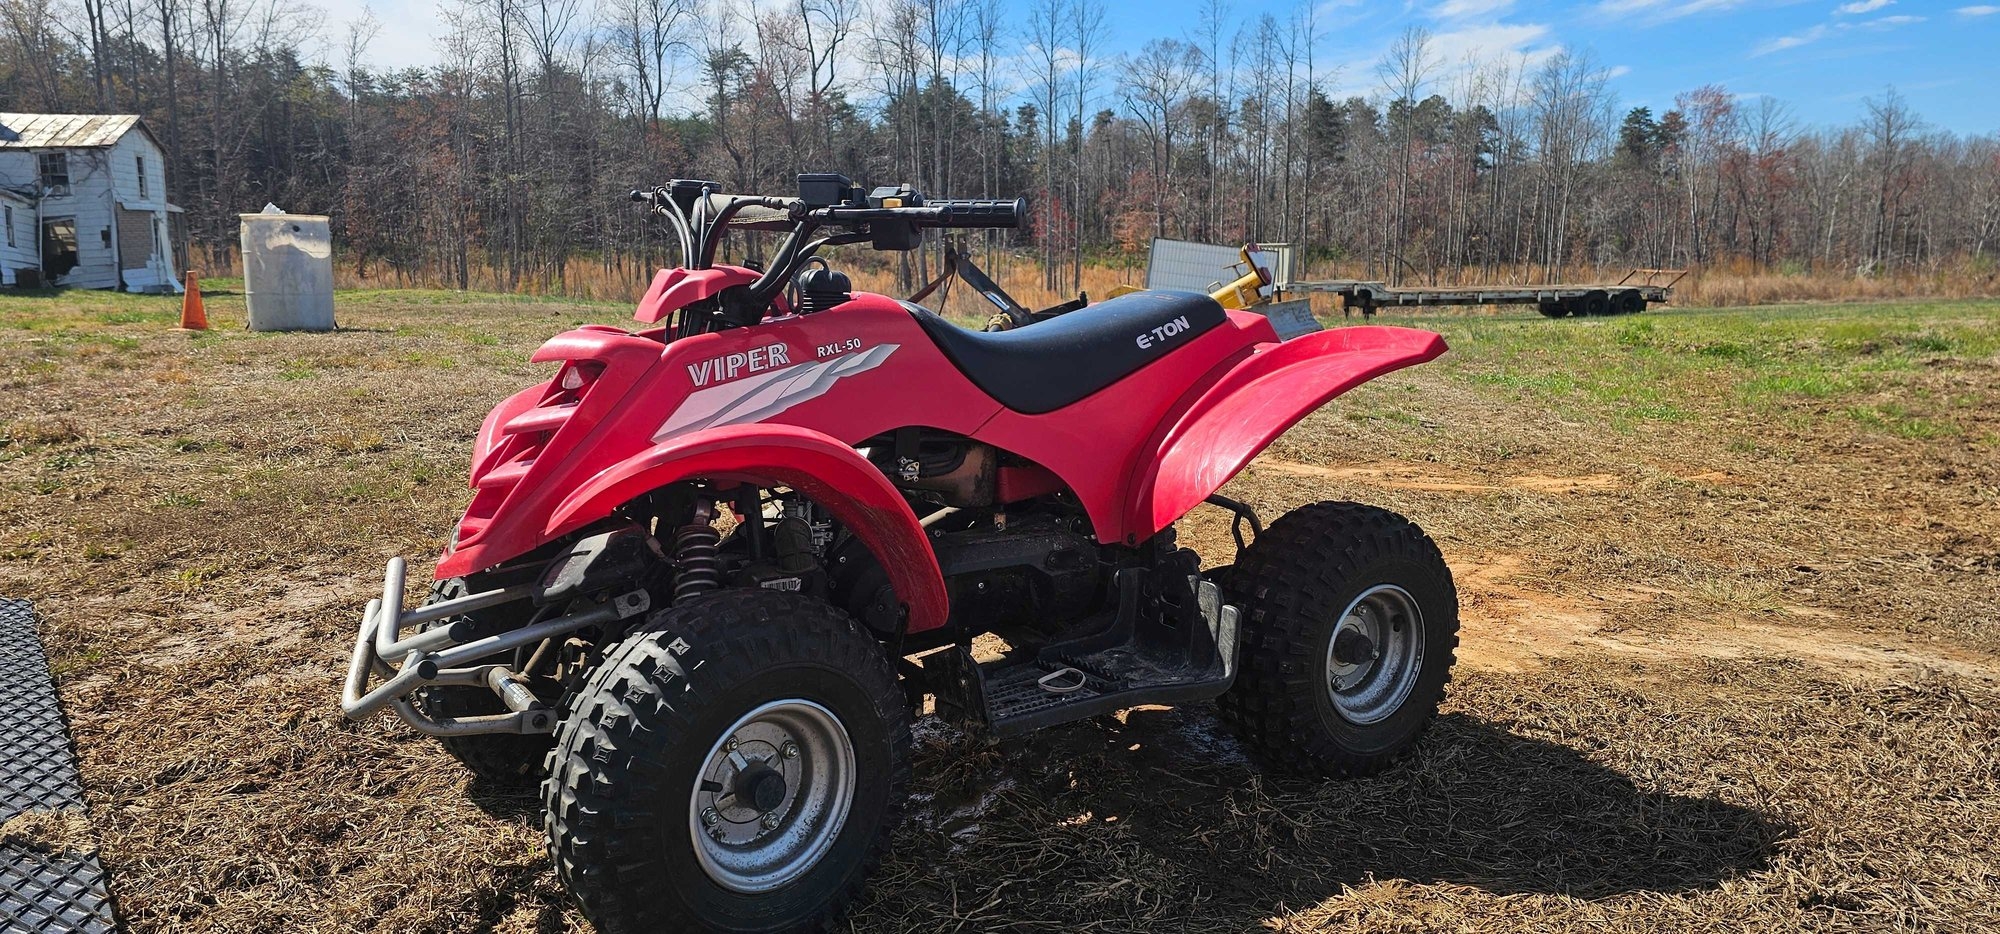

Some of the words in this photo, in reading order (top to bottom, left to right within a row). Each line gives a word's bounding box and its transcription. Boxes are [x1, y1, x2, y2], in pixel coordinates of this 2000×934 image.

[1136, 315, 1190, 349] E-TON
[687, 342, 791, 387] VIPER
[817, 338, 861, 357] RXL-50
